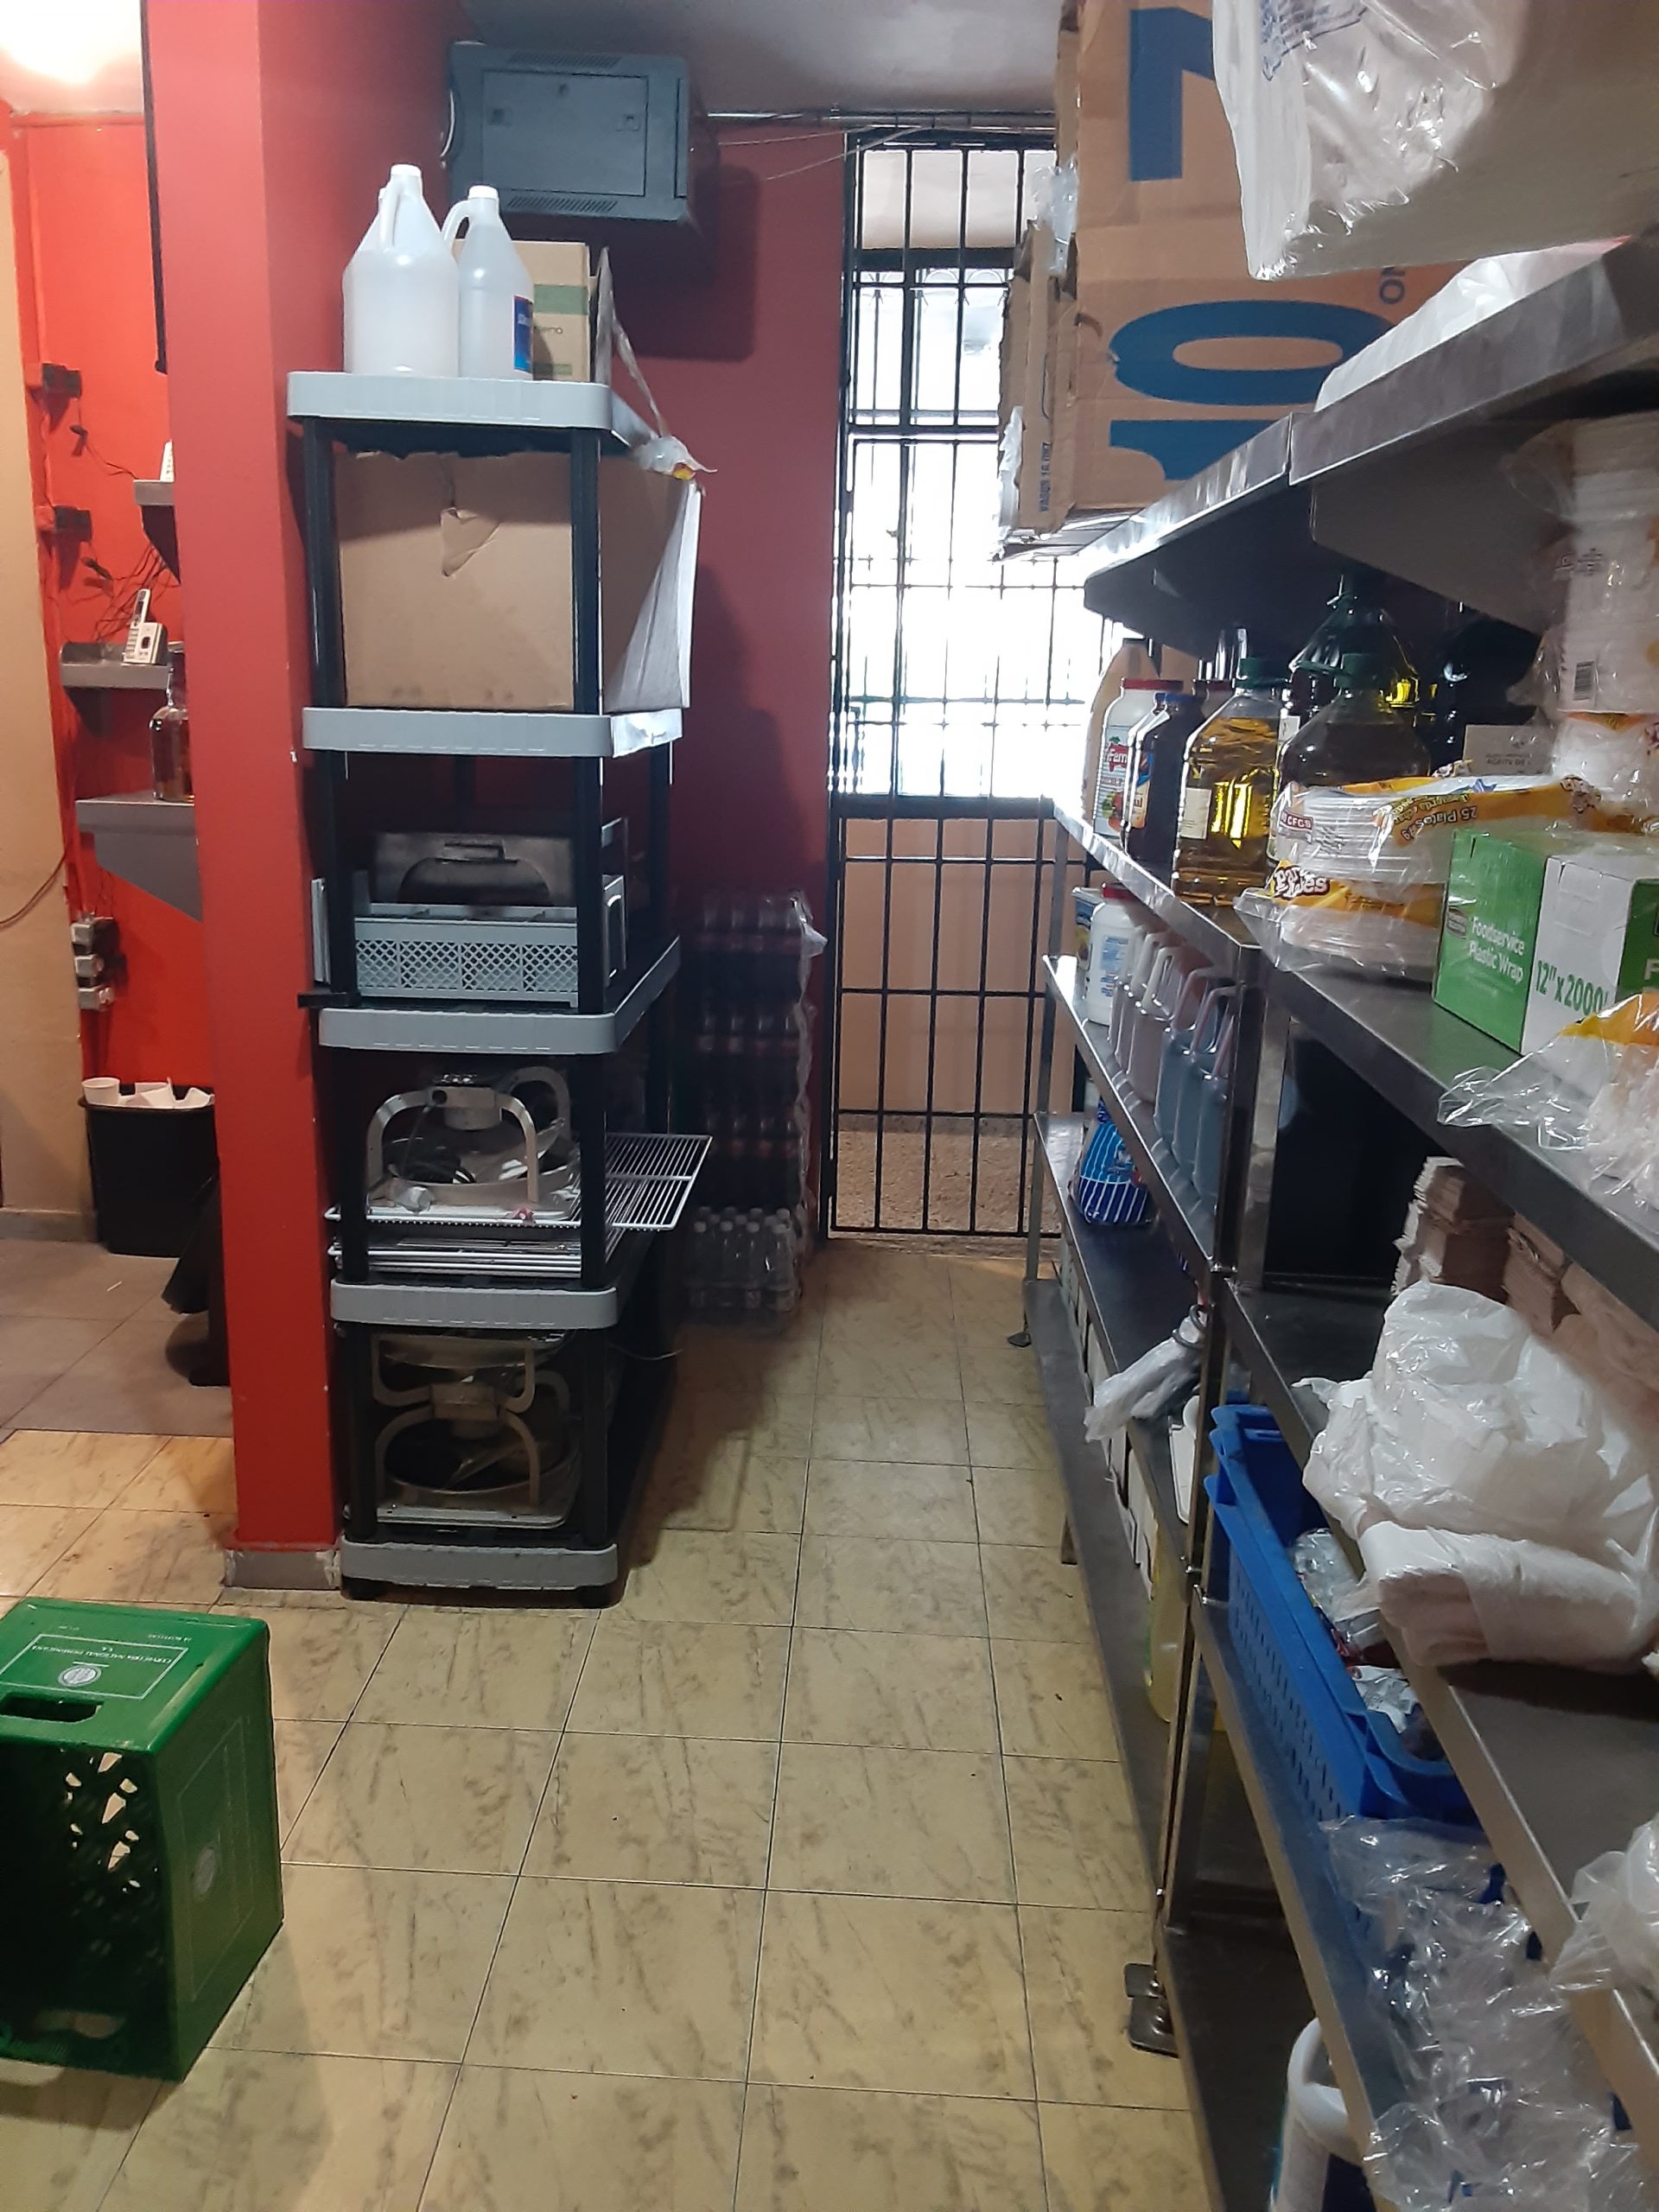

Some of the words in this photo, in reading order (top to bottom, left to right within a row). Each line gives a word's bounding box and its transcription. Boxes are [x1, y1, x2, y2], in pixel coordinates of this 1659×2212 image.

[1108, 299, 1395, 480] 10
[1416, 810, 1457, 829] Platos
[1460, 806, 1478, 820] 25
[1471, 917, 1525, 956] Foodservice
[1470, 940, 1497, 970] Plastic
[1497, 952, 1524, 984] Wrap
